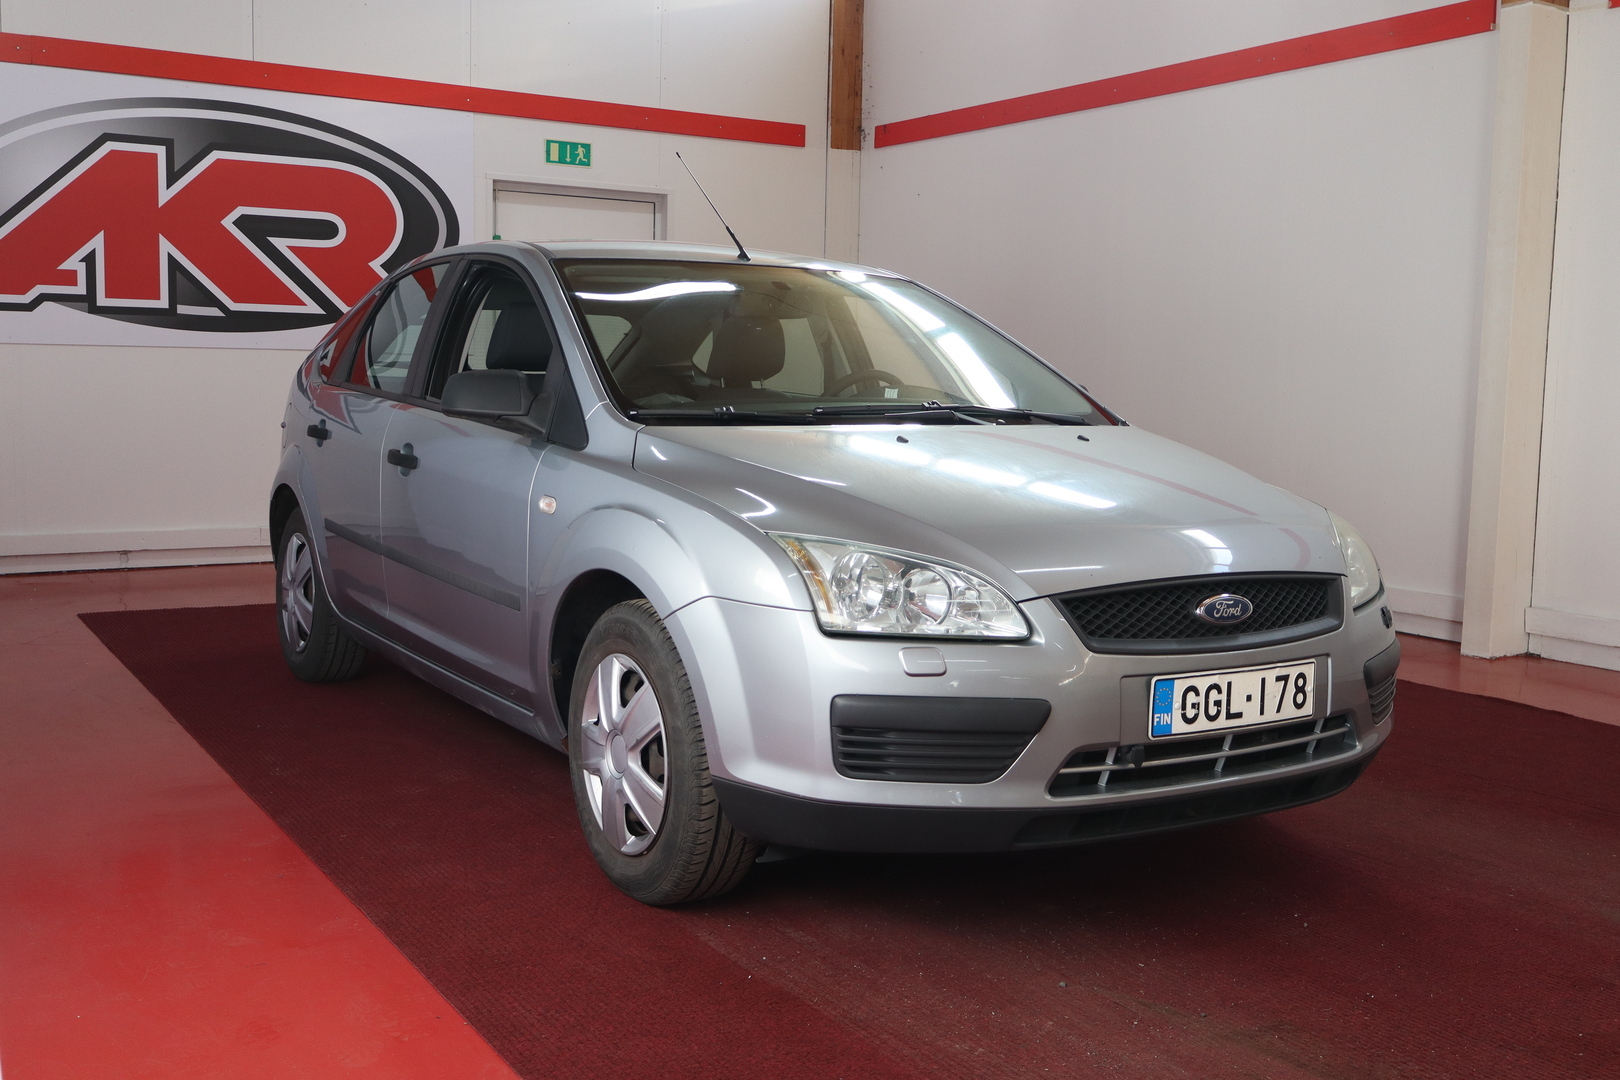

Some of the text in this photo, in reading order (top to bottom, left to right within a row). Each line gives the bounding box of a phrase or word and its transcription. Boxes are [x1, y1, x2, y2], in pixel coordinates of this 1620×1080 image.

[0, 140, 405, 314] AKR
[1213, 600, 1242, 617] Ford
[1181, 672, 1307, 725] GGL-178
[1153, 713, 1171, 726] FIN
